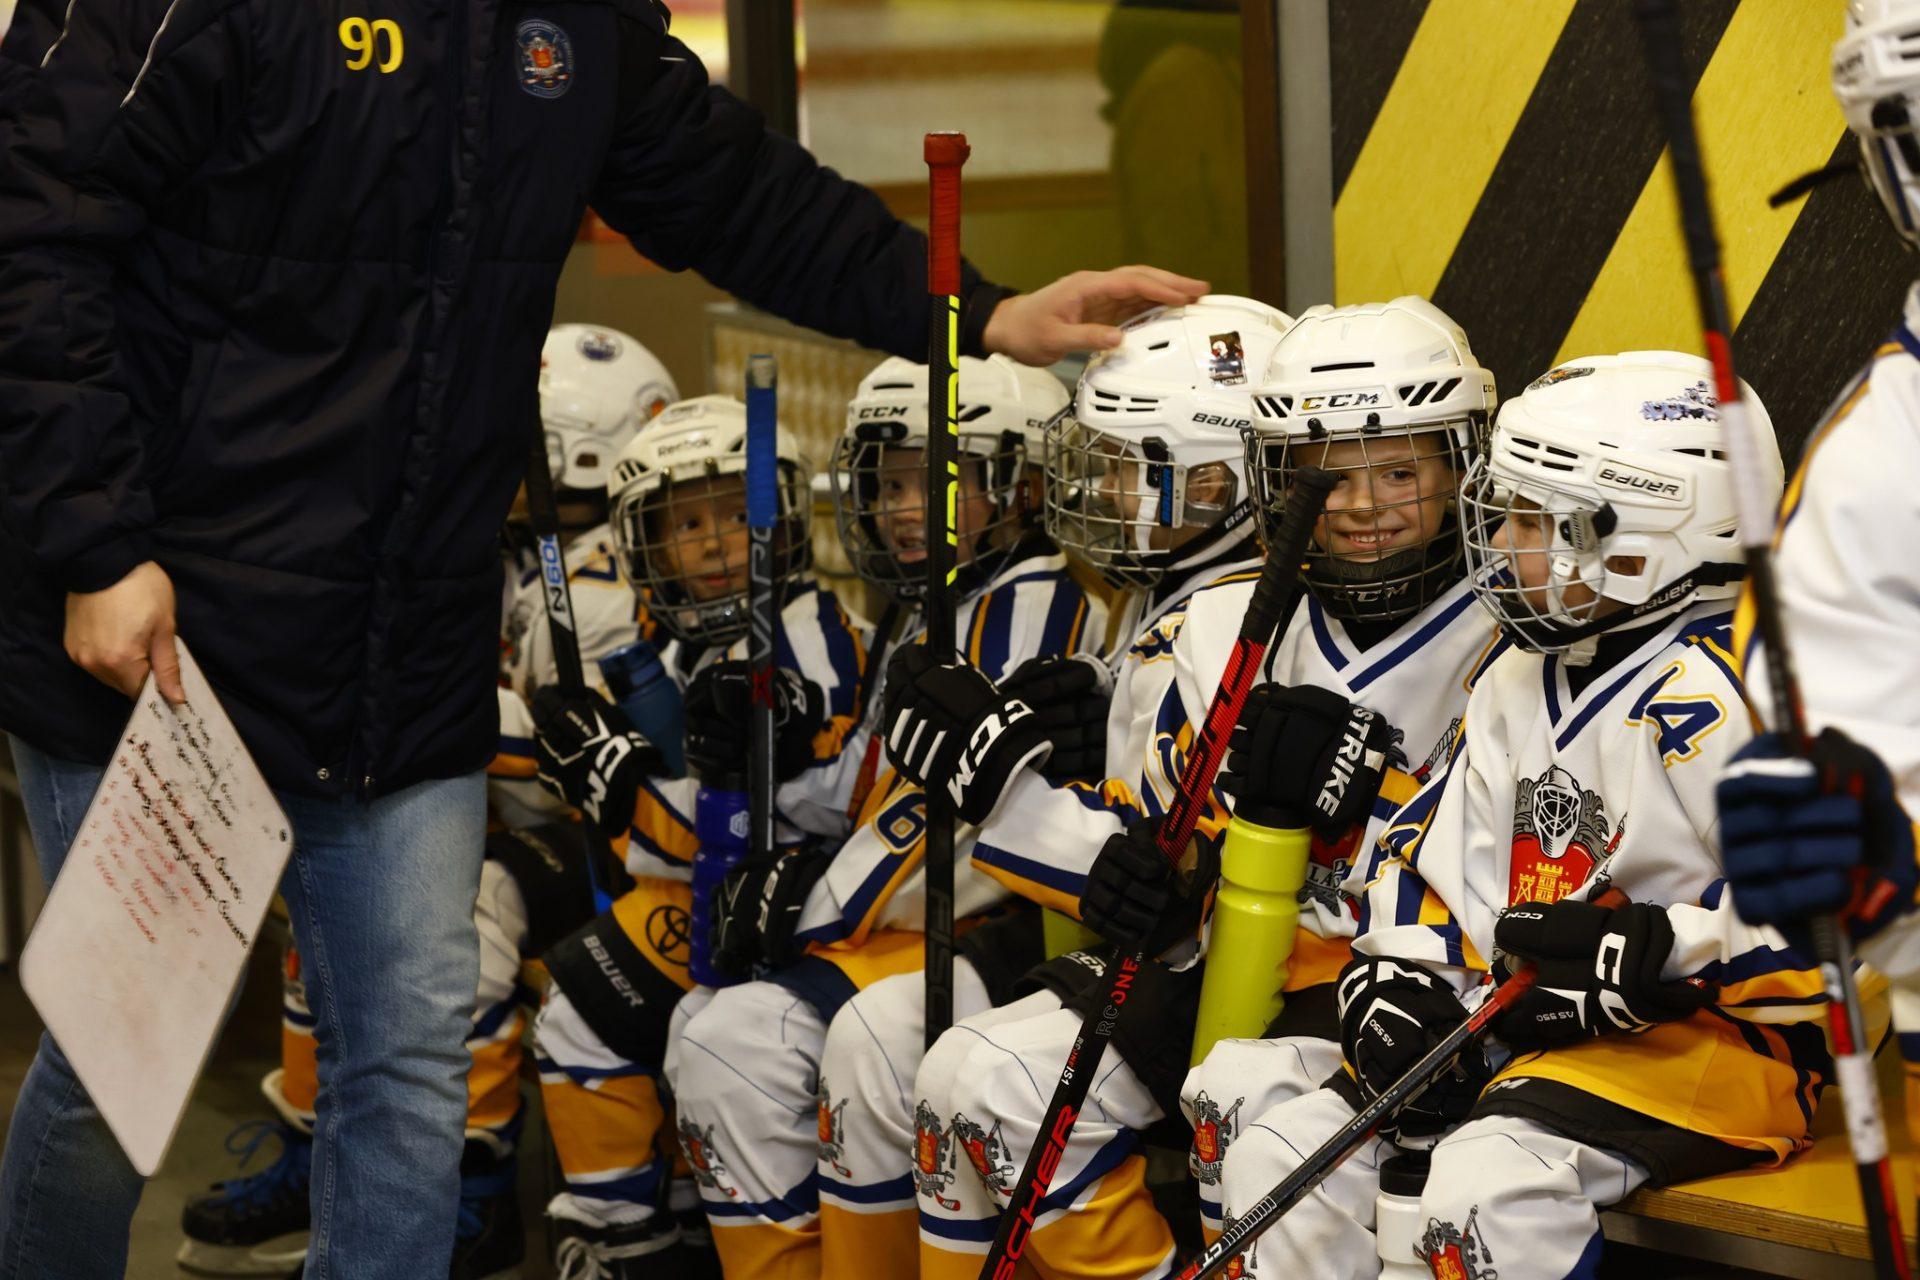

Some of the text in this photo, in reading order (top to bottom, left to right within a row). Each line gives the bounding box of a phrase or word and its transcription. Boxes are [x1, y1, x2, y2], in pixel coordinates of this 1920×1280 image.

[338, 17, 404, 74] 90
[858, 406, 909, 419] CCM
[1302, 393, 1380, 411] CCM
[1192, 412, 1251, 429] BAUE
[1599, 467, 1680, 497] BAUER
[946, 699, 1035, 808] CCM
[1315, 707, 1374, 817] STRIKE
[580, 935, 644, 1008] BAUER
[1368, 1019, 1395, 1047] AS 550
[1061, 1066, 1075, 1086] IS1
